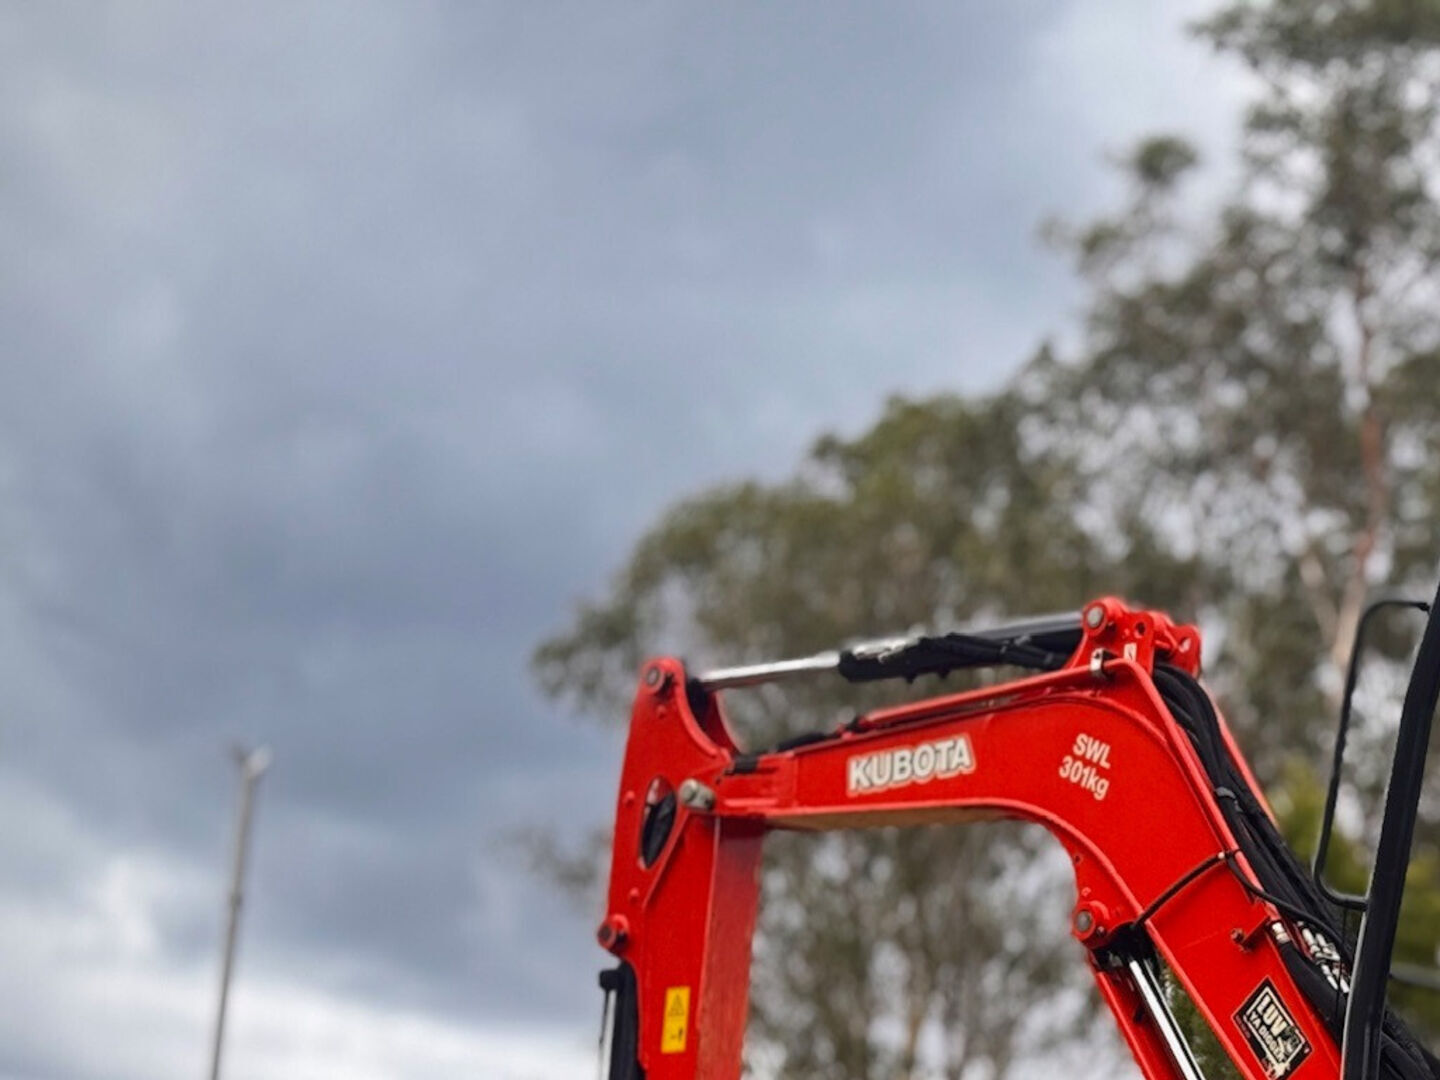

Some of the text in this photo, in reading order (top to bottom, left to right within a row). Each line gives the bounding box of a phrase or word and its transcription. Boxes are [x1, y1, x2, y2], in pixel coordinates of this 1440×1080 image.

[848, 735, 974, 793] KUBOTA
[1073, 733, 1111, 769] SWL
[1058, 756, 1110, 801] 301kg
[1249, 1011, 1261, 1028] YA
[1256, 994, 1288, 1037] LUV
